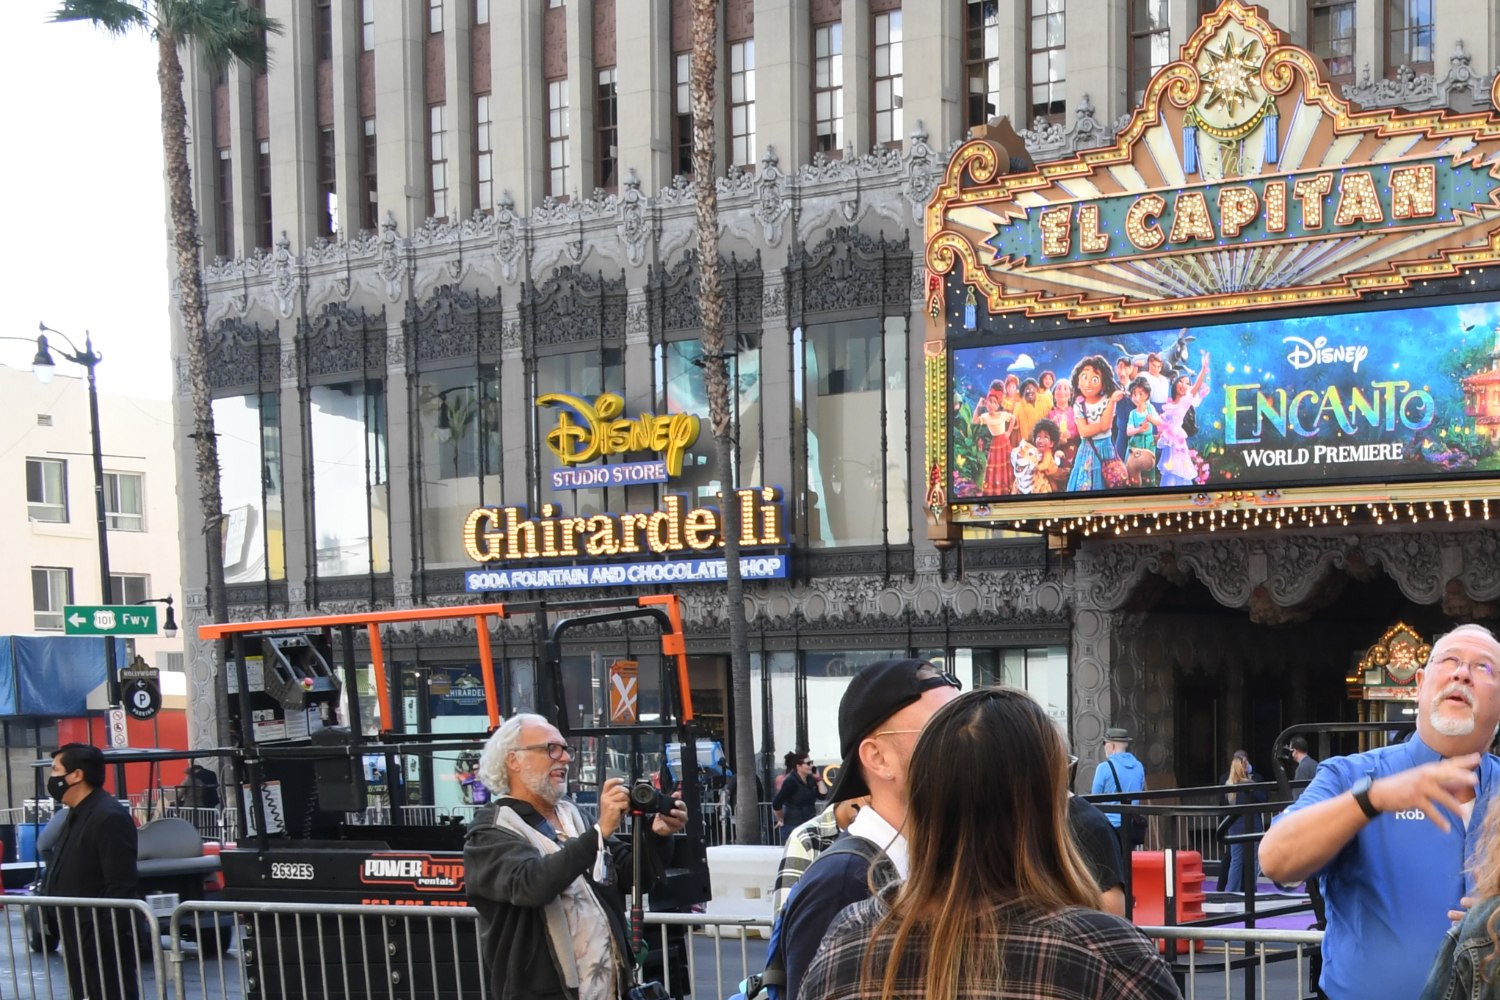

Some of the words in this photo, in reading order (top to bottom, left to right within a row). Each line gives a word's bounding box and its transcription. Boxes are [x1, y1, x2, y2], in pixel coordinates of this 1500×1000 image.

[1040, 204, 1108, 258] EL
[1125, 164, 1437, 252] CAPITAN
[1223, 380, 1436, 445] ENCANTO
[1242, 449, 1310, 468] WORLD
[1313, 442, 1404, 466] PREMIERE
[553, 469, 610, 488] STUDIO
[613, 463, 666, 483] STORE
[463, 486, 781, 563] Ghirardeli
[468, 571, 511, 590] SODA
[511, 567, 588, 588] FOUNTAIN
[591, 564, 626, 585] AND
[627, 560, 728, 582] CHOCOLATE
[739, 558, 782, 577] HOP
[98, 616, 111, 625] 101
[122, 613, 149, 628] Fwy
[271, 863, 314, 880] 2632ES
